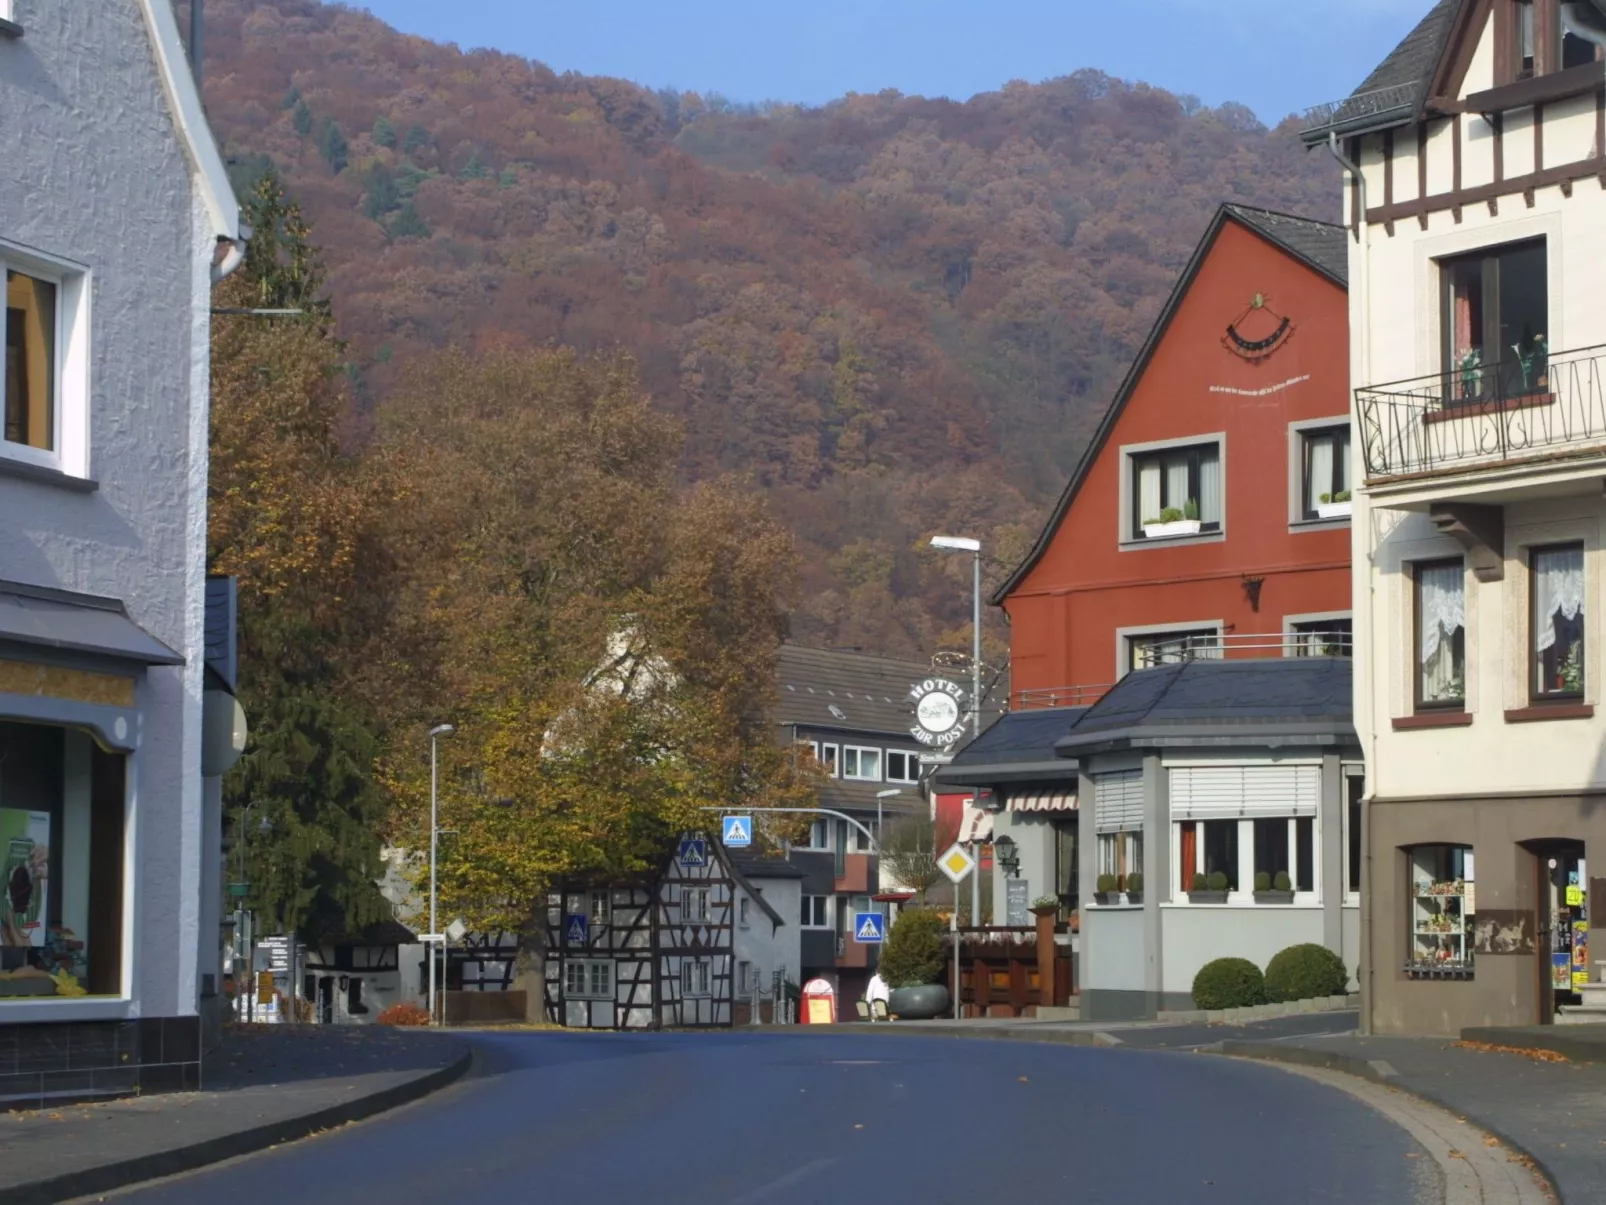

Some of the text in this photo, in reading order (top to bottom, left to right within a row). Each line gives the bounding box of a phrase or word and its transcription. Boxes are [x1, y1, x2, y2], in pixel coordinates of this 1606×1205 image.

[910, 679, 964, 701] HOTEL
[910, 722, 966, 745] ZUR POST
